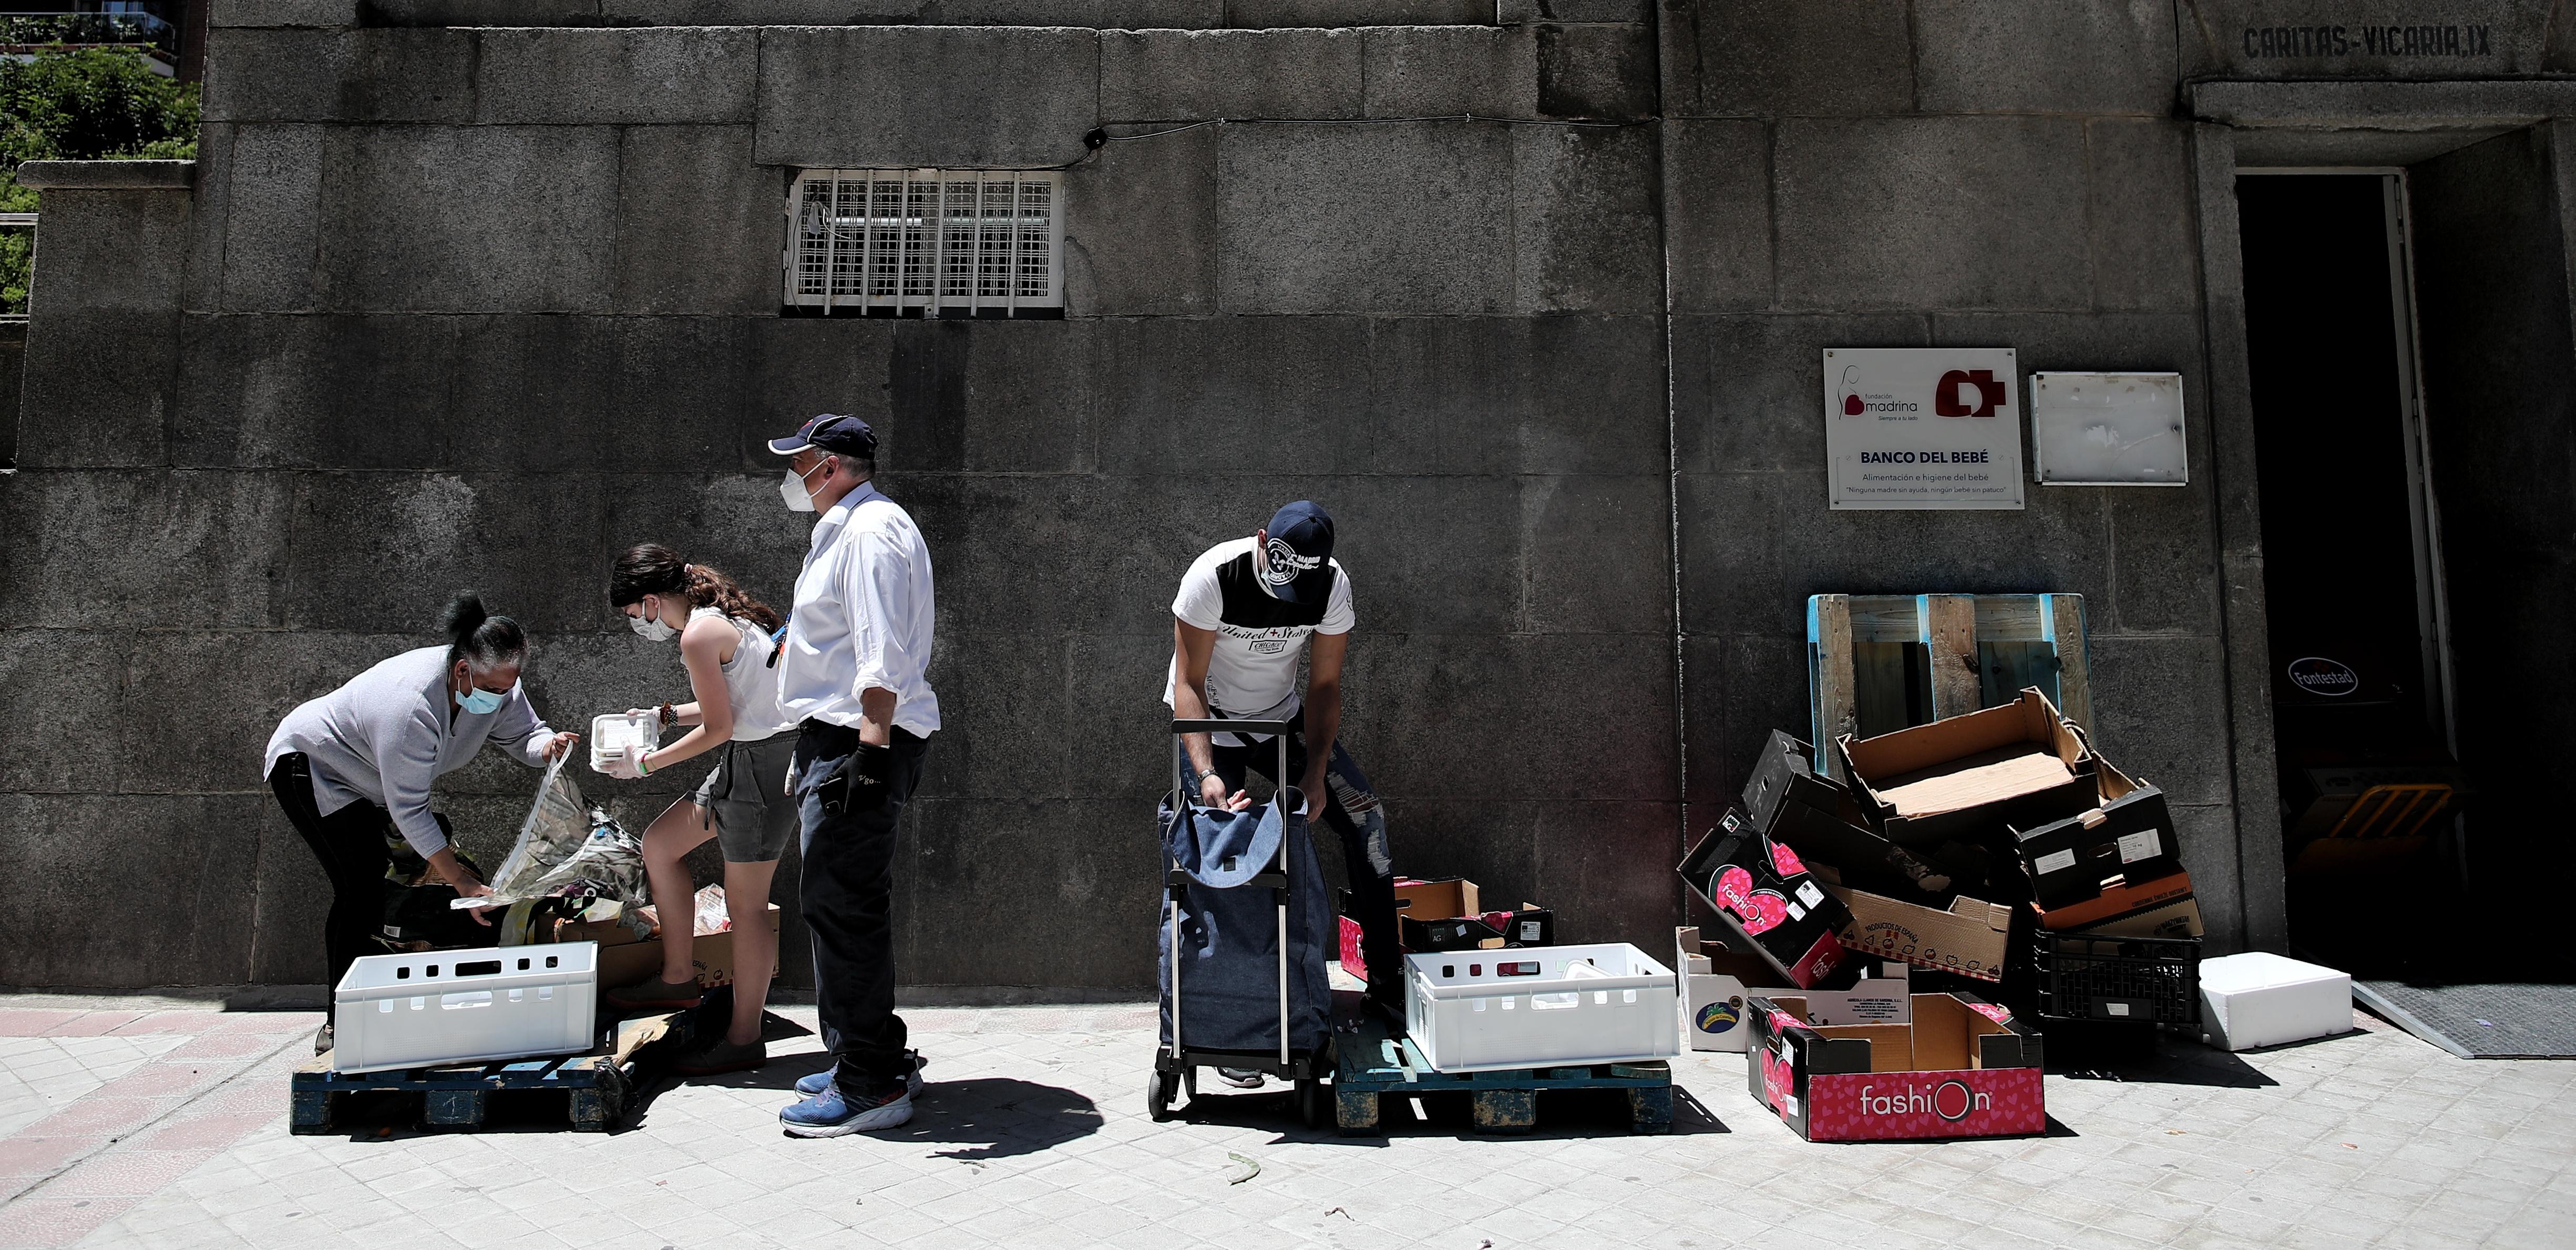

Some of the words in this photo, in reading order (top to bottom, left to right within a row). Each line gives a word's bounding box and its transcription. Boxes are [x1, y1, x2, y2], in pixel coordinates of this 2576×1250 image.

[1866, 400, 1917, 412] madrina
[1861, 451, 1915, 463] BANCO
[1920, 451, 1948, 463] DEL
[1952, 448, 1989, 463] BEBÉ
[1923, 474, 1952, 483] higiene
[1297, 555, 1321, 564] MADRID
[1222, 626, 1270, 639] United
[2294, 670, 2354, 685] Fontestad
[1865, 922, 1895, 933] PRODUCTOS
[1901, 927, 1918, 944] ESPAÑA
